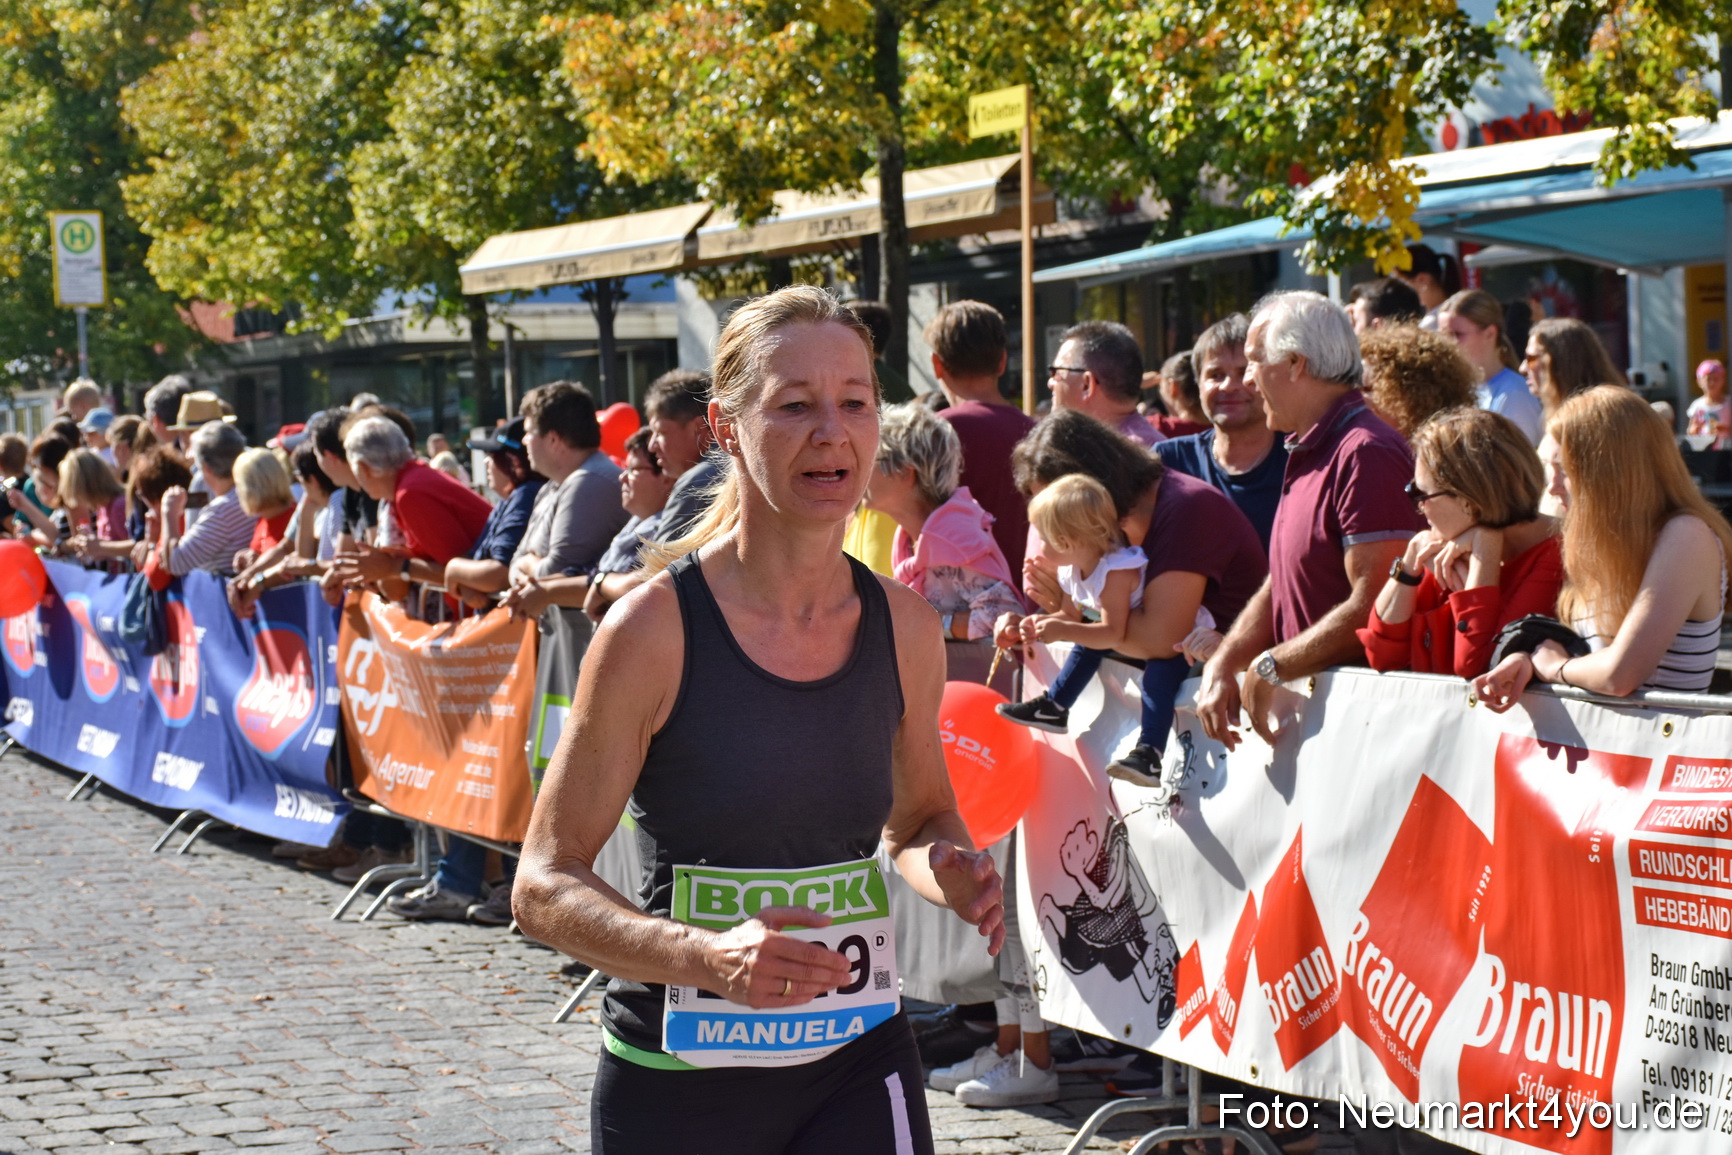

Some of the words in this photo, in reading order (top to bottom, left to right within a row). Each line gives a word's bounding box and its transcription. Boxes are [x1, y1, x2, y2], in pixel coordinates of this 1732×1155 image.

[981, 103, 1022, 122] Toiletten
[381, 753, 436, 791] Agentur
[954, 748, 994, 771] energie
[1671, 763, 1732, 789] BINDEST
[1649, 805, 1732, 833] VERZURRS
[1589, 830, 1603, 863] Seit
[693, 871, 872, 920] BOCK
[1469, 897, 1480, 922] Seit
[1476, 865, 1492, 896] 1929
[1645, 896, 1732, 933] HEBEBÄND
[876, 935, 885, 947] D
[1342, 909, 1433, 1051] Braun
[1651, 952, 1687, 984] Braun
[1261, 946, 1335, 1035] Braun
[1649, 984, 1668, 1011] Am
[1671, 988, 1732, 1024] Grünber
[696, 1016, 866, 1045] MANUELA
[1298, 1001, 1322, 1031] Sicher
[1369, 1009, 1387, 1047] Sicher
[1465, 952, 1612, 1079] Braun
[1645, 1014, 1699, 1050] D-92318
[1641, 1058, 1667, 1087] Tel.
[1671, 1065, 1714, 1096] 09181
